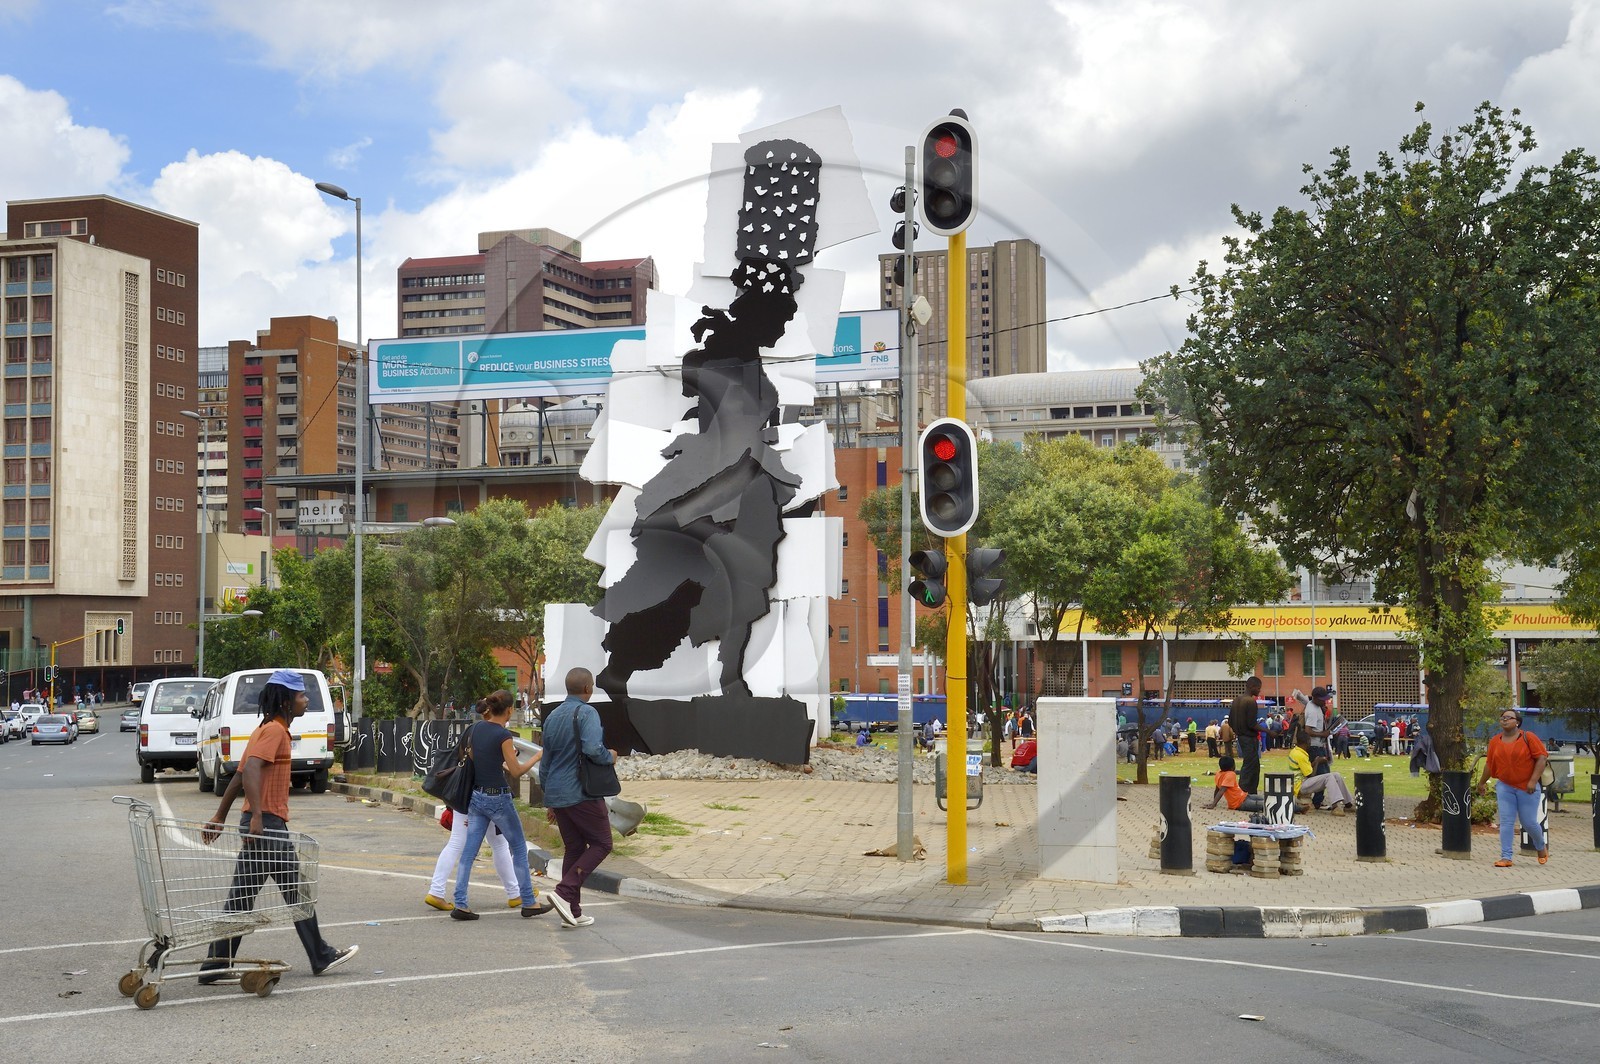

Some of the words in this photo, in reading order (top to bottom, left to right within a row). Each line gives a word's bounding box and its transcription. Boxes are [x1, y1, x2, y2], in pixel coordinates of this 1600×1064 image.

[382, 360, 408, 369] MORE
[479, 362, 514, 371] REDUCE
[514, 363, 533, 371] your
[534, 359, 578, 370] BUSINESS
[580, 357, 610, 367] STRES
[871, 355, 889, 363] FNB
[382, 368, 418, 377] BUSINESS
[420, 366, 456, 375] ACCOUNT.
[298, 503, 347, 515] metro
[1257, 614, 1327, 629] ngebotsotso
[1513, 613, 1570, 625] Khuluma
